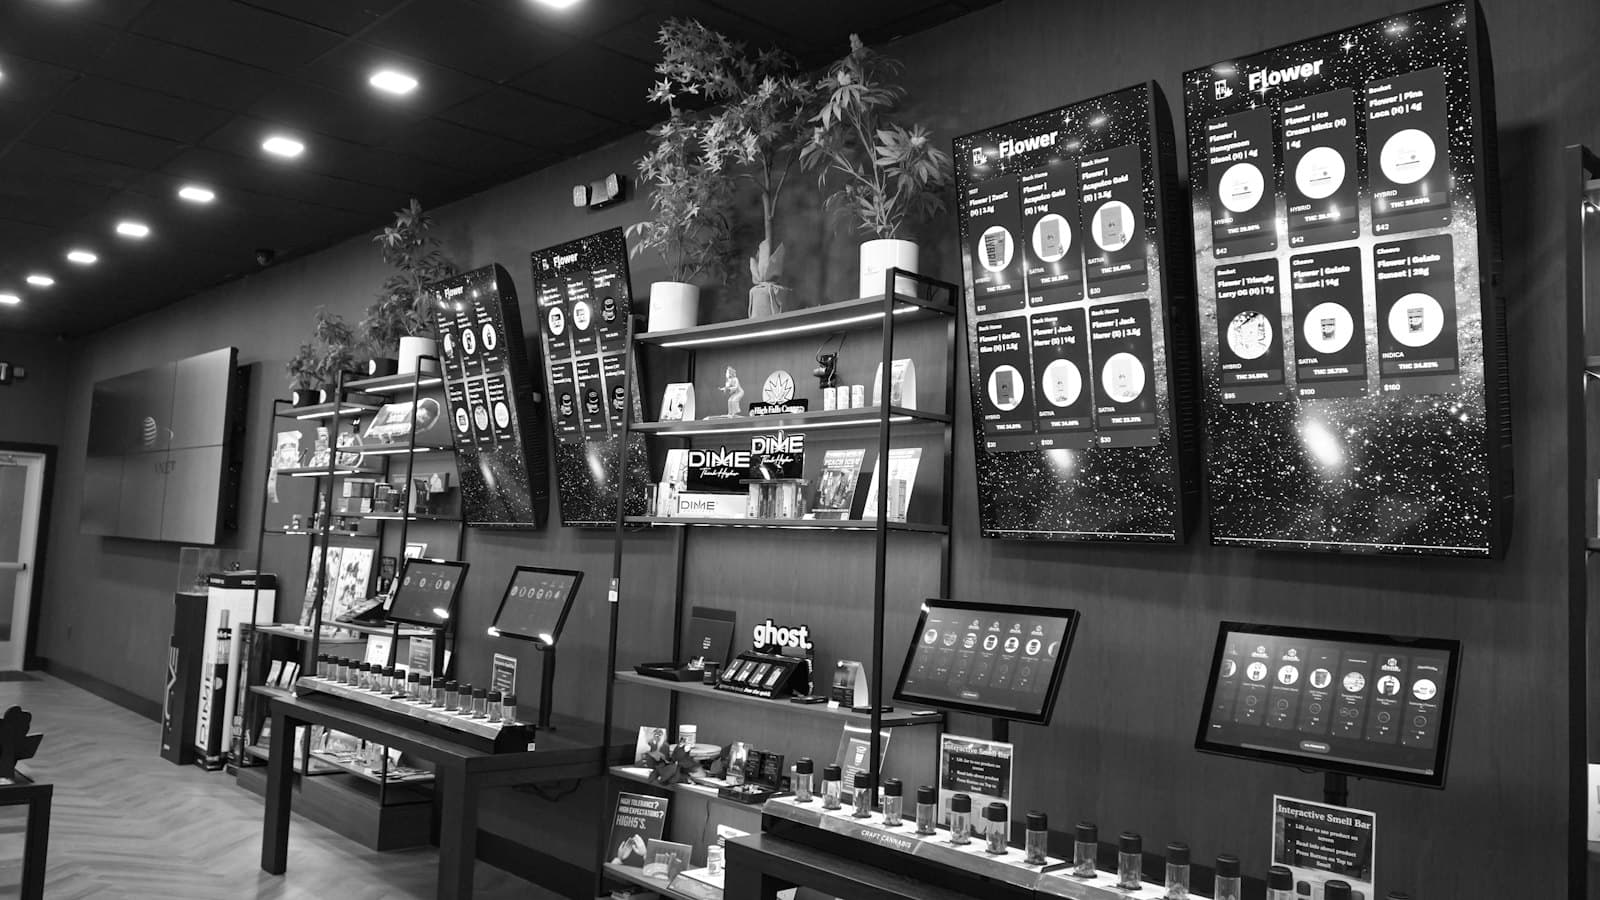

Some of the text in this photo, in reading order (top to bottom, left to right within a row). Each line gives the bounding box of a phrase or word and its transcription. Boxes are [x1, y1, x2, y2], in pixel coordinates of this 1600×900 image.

[1249, 59, 1323, 91] Flower
[1369, 96, 1398, 107] Flower
[1285, 114, 1311, 126] Flower
[1209, 131, 1233, 143] Flower
[999, 130, 1058, 158] Flower
[1081, 169, 1104, 180] Flower
[1023, 183, 1044, 194] Flower
[1374, 190, 1397, 198] HYBRID
[969, 197, 989, 206] Flower
[1290, 204, 1311, 213] HYBRID
[1376, 223, 1389, 231] $42
[1291, 236, 1304, 244] $42
[1216, 247, 1228, 255] $42
[553, 253, 578, 267] Flower
[1377, 254, 1440, 268] Flower Gelato
[1293, 265, 1350, 278] Flower Gelato
[1217, 279, 1241, 288] Flower
[444, 286, 463, 298] Flower
[1092, 320, 1114, 329] Flower
[1033, 328, 1054, 336] Flower
[979, 334, 998, 343] Flower
[751, 430, 804, 455] DIME
[688, 446, 750, 468] DIME
[680, 498, 716, 511] DIME
[753, 620, 812, 649] ghost.
[944, 742, 978, 754] Interactive
[630, 799, 659, 809] TOLERANCE?
[629, 807, 664, 819] EXPECTATIONS?
[1278, 804, 1371, 830] Interactive Smell Bar
[861, 829, 881, 840] CRAFT
[1329, 830, 1350, 840] product
[1295, 849, 1309, 857] Press
[1309, 851, 1328, 861] Button
[1309, 842, 1319, 850] info
[1320, 845, 1335, 853] about
[1335, 849, 1357, 858] product
[1316, 860, 1331, 869] Smell
